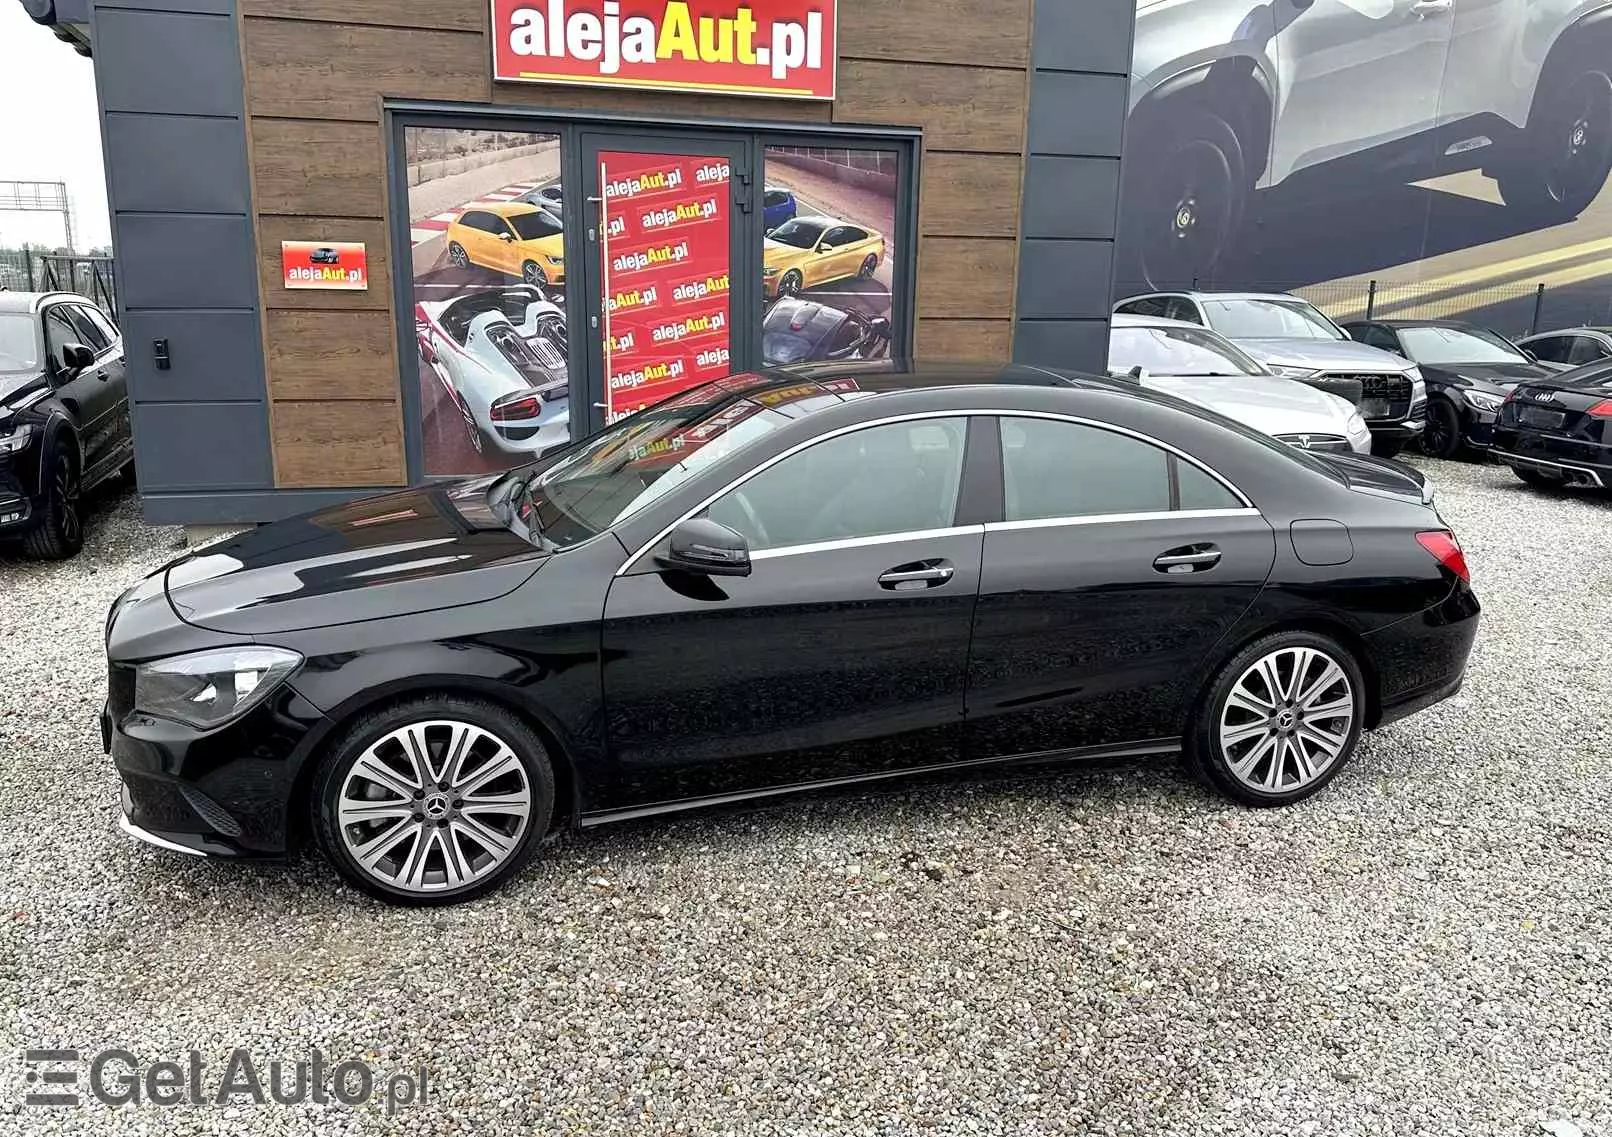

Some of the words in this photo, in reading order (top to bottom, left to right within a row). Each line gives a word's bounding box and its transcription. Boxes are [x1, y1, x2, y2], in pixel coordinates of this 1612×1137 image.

[509, 0, 823, 80] alejaAut.pl
[605, 168, 682, 197] alejaAut.pl
[695, 163, 730, 182] aleja
[641, 199, 717, 227] alejaAut.pl
[613, 242, 689, 271] alejaAut.pl
[288, 266, 362, 283] alejaAut.pl
[652, 312, 726, 341] alejaAut.pl
[696, 347, 730, 366] aleja
[611, 359, 684, 389] alejaAut.pl
